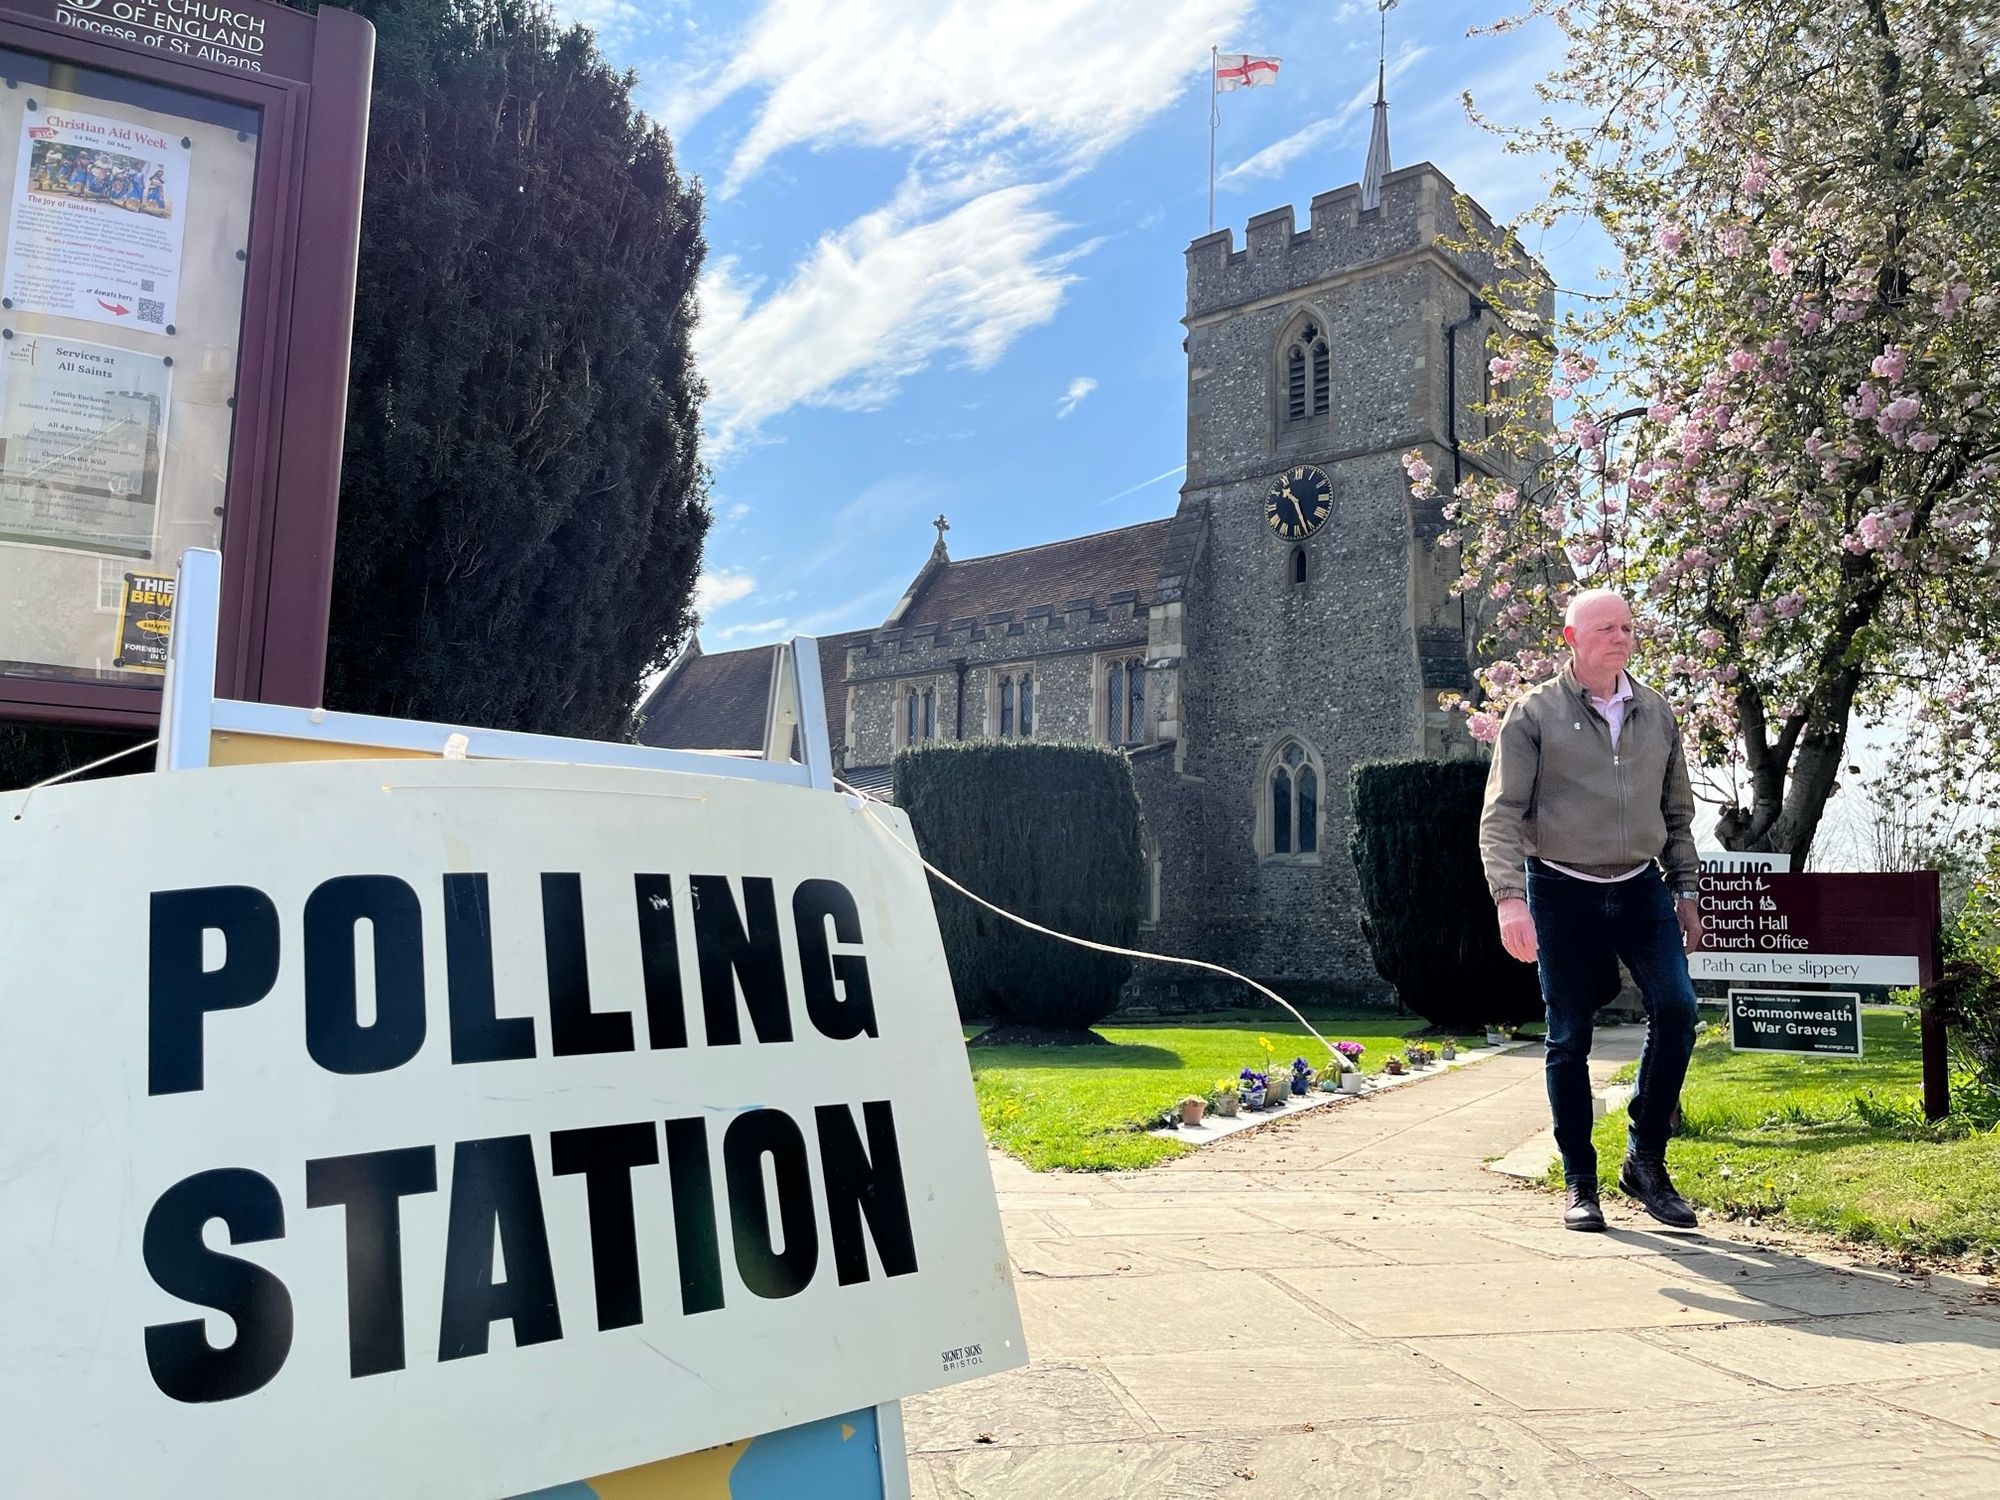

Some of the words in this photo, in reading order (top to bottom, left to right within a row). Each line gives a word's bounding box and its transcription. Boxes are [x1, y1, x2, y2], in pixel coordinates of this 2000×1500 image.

[168, 0, 265, 34] CHURCH
[113, 2, 146, 22] OF
[154, 12, 264, 52] ENGLAND
[56, 9, 137, 42] Diocese
[144, 34, 164, 48] of
[169, 37, 191, 54] St
[197, 45, 262, 73] Albans
[46, 115, 104, 134] Christian
[108, 126, 131, 140] Aid
[134, 129, 168, 150] Week
[28, 194, 42, 203] The
[43, 197, 55, 207] joy
[58, 198, 66, 207] of
[68, 203, 96, 214] success
[94, 288, 117, 299] donate
[118, 293, 133, 302] here
[56, 347, 100, 362] Services
[104, 356, 116, 365] at
[58, 362, 74, 372] All
[78, 365, 112, 378] Saints
[134, 578, 175, 593] THIE
[130, 590, 173, 606] BEW
[144, 622, 170, 630] SMART
[124, 643, 164, 654] FORENSIC
[1699, 876, 1752, 891] Church
[1700, 896, 1753, 910] Church
[1701, 915, 1754, 930] Church
[1759, 915, 1788, 930] Hall
[1701, 933, 1755, 948] Church
[1760, 934, 1809, 949] Office
[1702, 958, 1734, 972] Path
[1740, 963, 1767, 973] can
[1772, 959, 1792, 973] be
[1799, 960, 1860, 979] slippery
[148, 872, 880, 1096] POLLING
[1736, 1005, 1852, 1022] Commonwealth
[1752, 1021, 1781, 1034] War
[1786, 1023, 1838, 1036] Graves
[142, 1100, 918, 1404] STATION
[942, 1348, 964, 1363] SIGNET
[965, 1344, 982, 1358] SIGNS
[943, 1357, 983, 1372] BRISTOL
